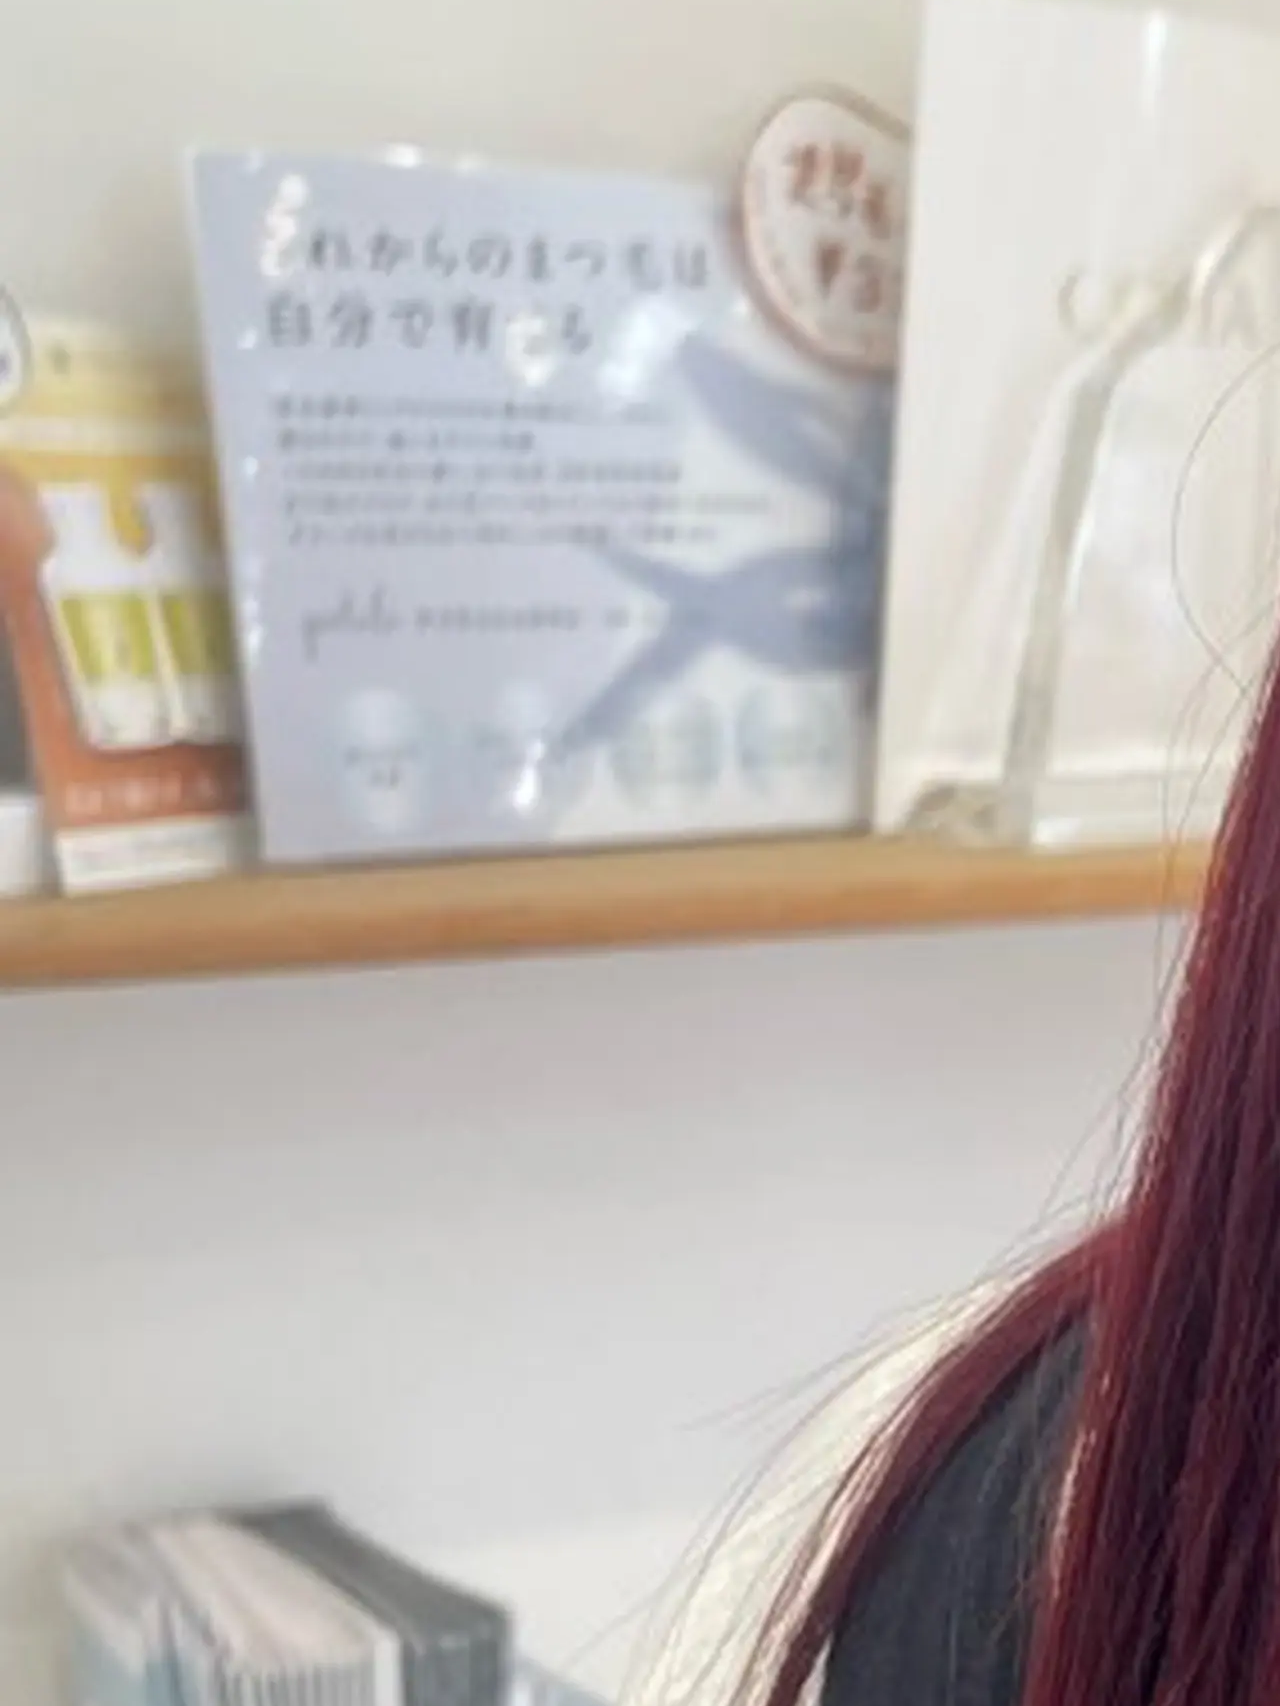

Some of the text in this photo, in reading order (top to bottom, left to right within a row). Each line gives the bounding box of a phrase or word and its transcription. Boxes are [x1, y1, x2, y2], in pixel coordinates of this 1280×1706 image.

[267, 291, 594, 357] 自分で育る
